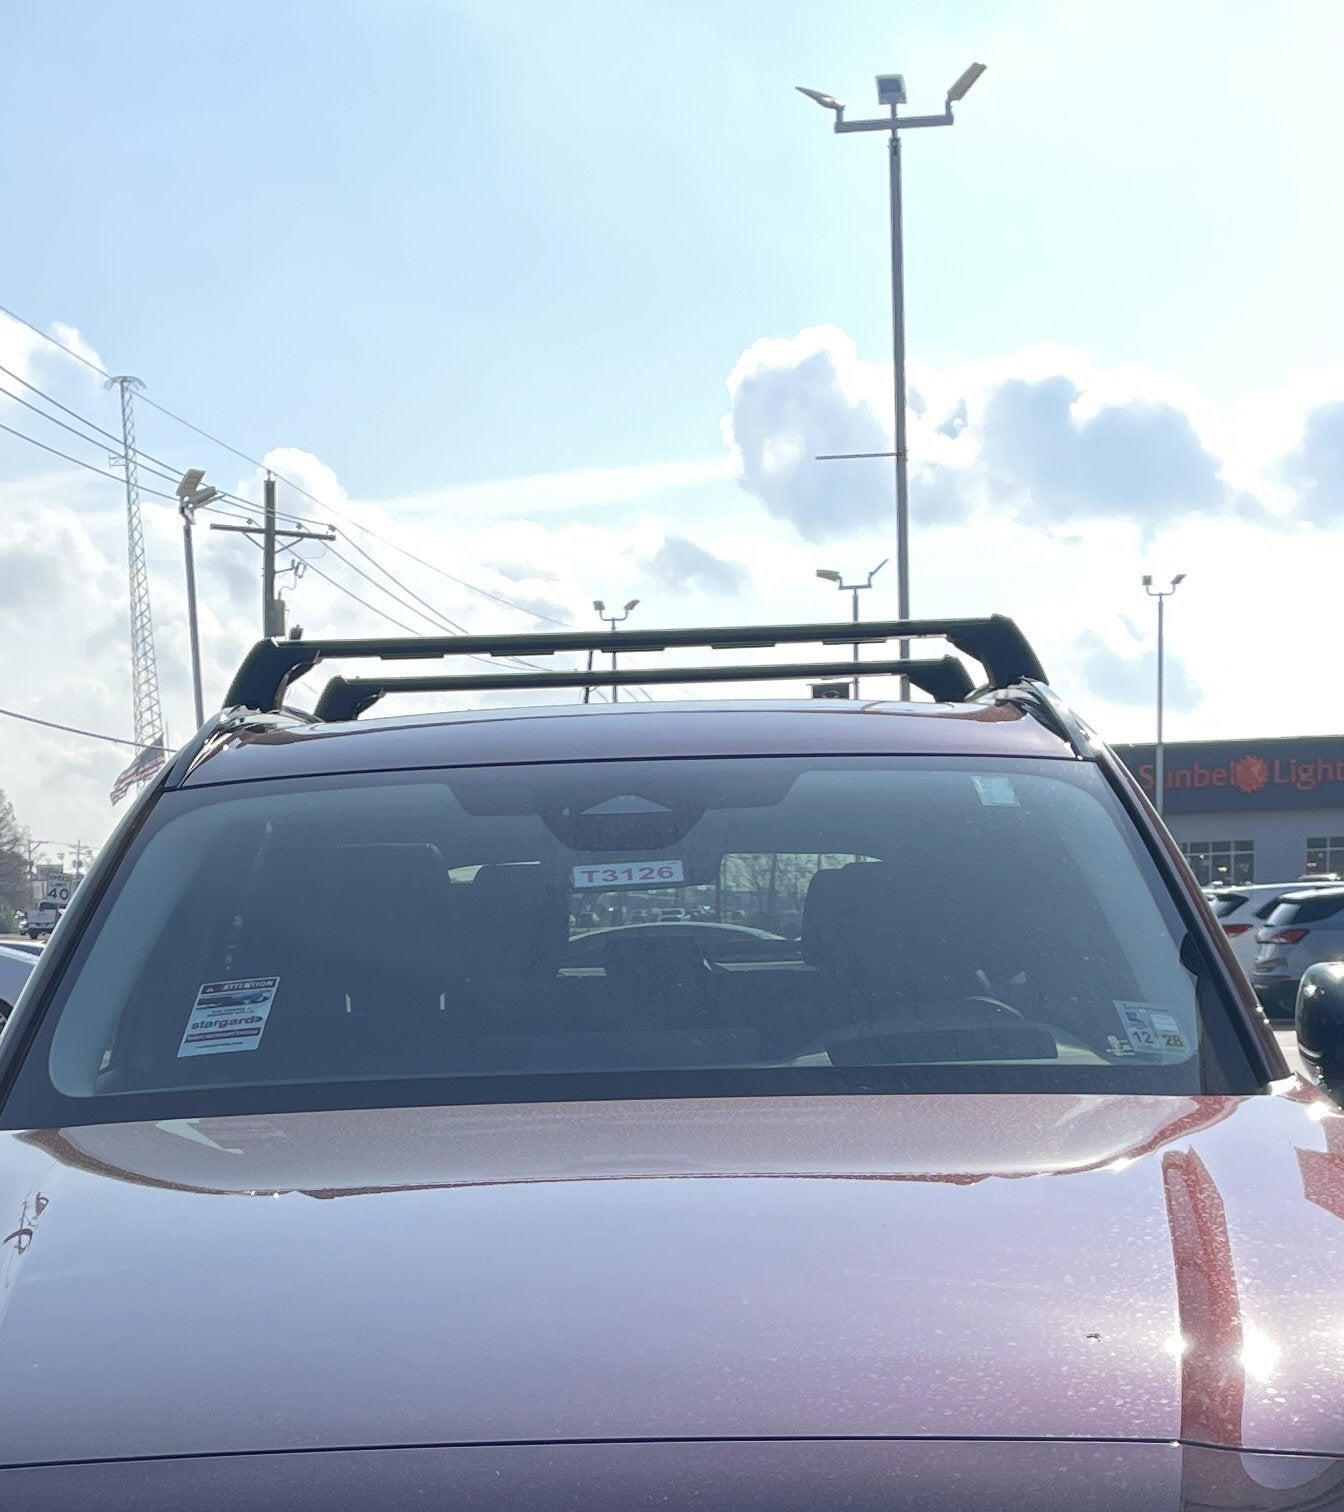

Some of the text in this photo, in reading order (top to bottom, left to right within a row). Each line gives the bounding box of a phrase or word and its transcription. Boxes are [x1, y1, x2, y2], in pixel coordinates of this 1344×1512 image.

[581, 866, 674, 883] T3126
[47, 888, 69, 900] 40
[222, 980, 274, 991] ATTENTION
[1132, 1031, 1184, 1048] 12 28
